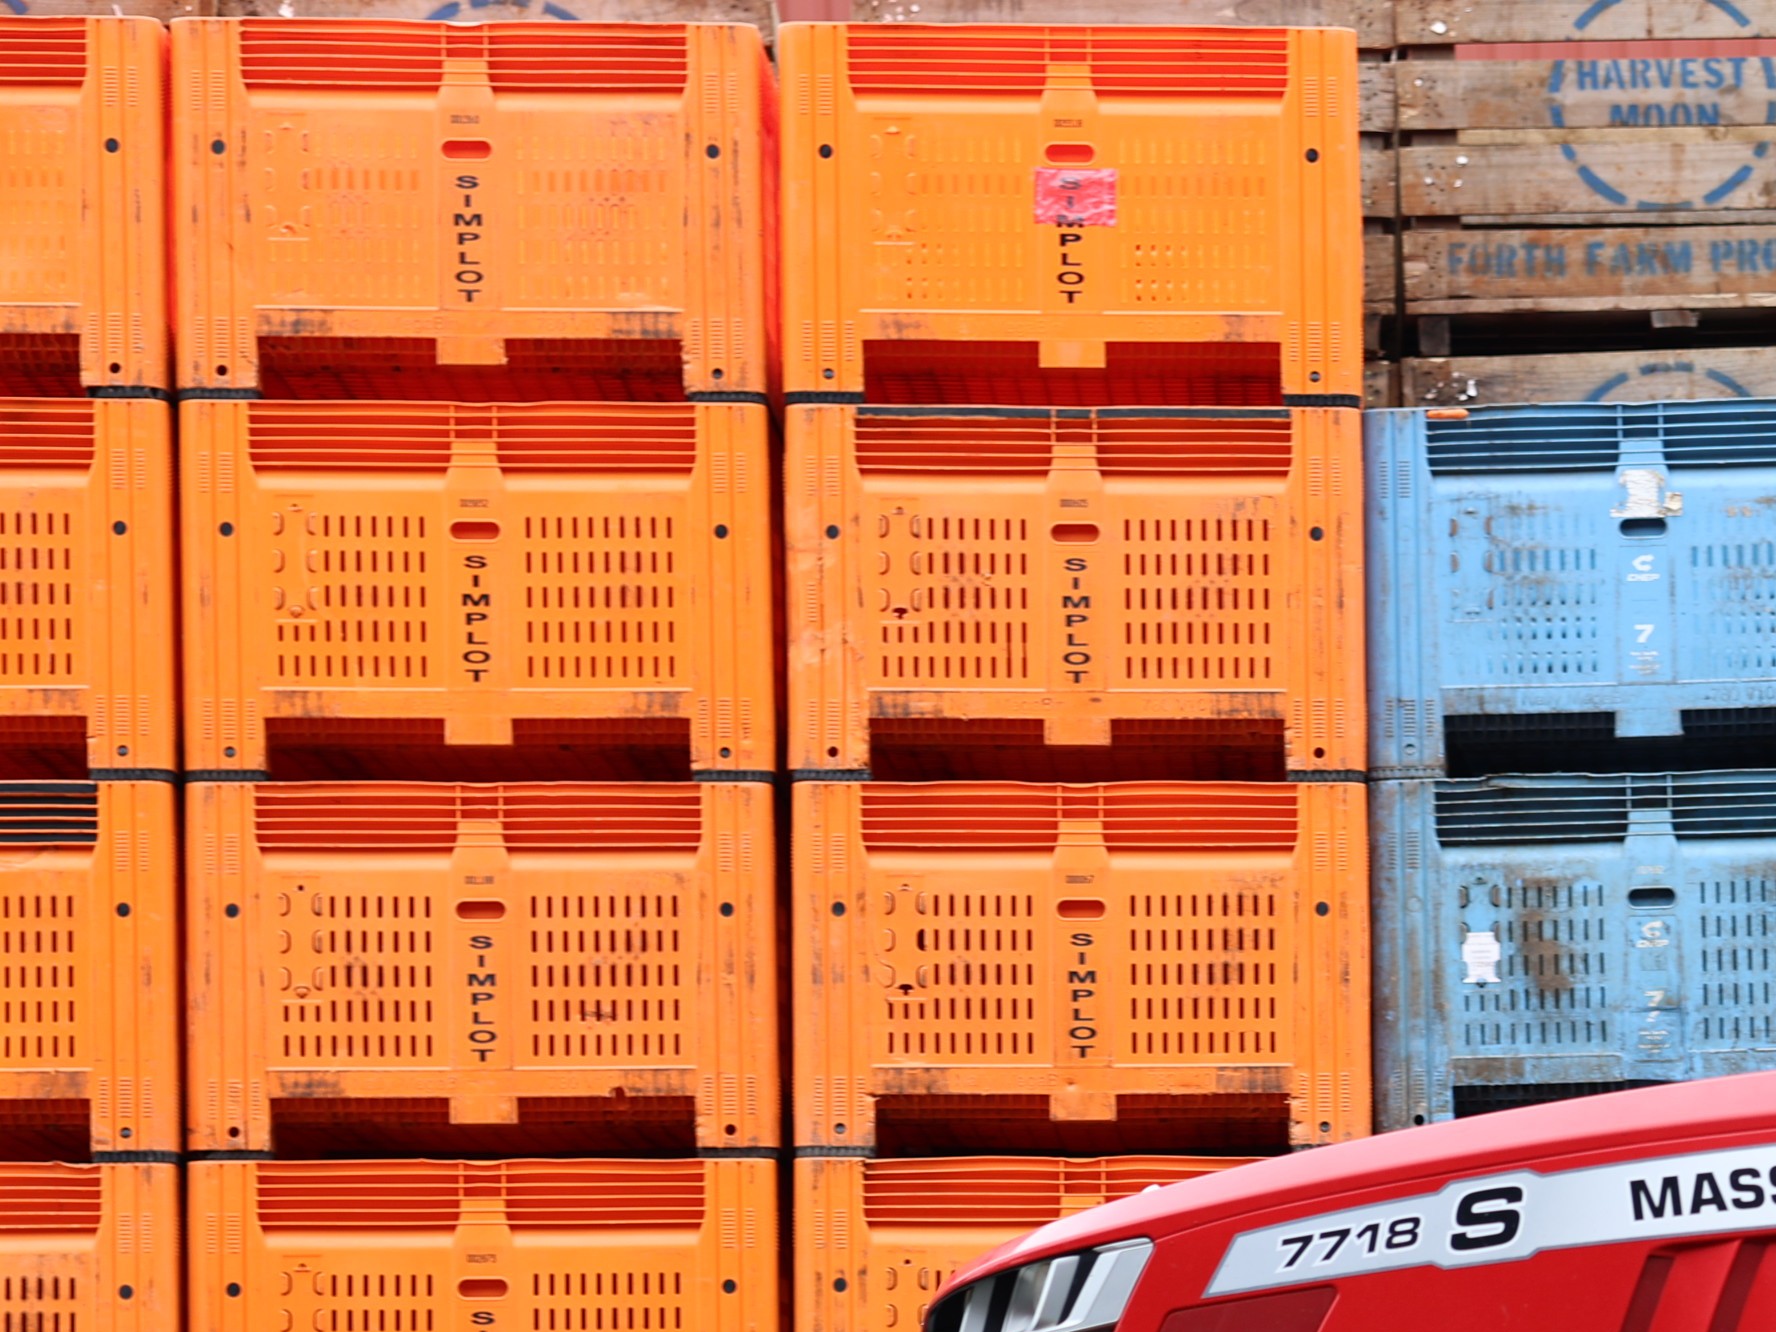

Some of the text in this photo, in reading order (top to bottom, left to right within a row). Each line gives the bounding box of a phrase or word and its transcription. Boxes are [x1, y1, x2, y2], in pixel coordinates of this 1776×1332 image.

[1576, 56, 1749, 92] HARVEST
[1609, 101, 1721, 126] MOON
[455, 176, 482, 302] SIMPLOT
[1056, 176, 1085, 304] SIMPLOT
[1447, 242, 1566, 277] FORTH
[1585, 240, 1693, 275] FARM
[463, 556, 490, 682] SIMPLOT
[1063, 558, 1090, 683] SIMPLOT
[468, 936, 496, 1062] SIMPLOT
[1069, 933, 1096, 1058] SIMPLOT
[1282, 1217, 1421, 1267] 7718
[1450, 1186, 1524, 1251] S
